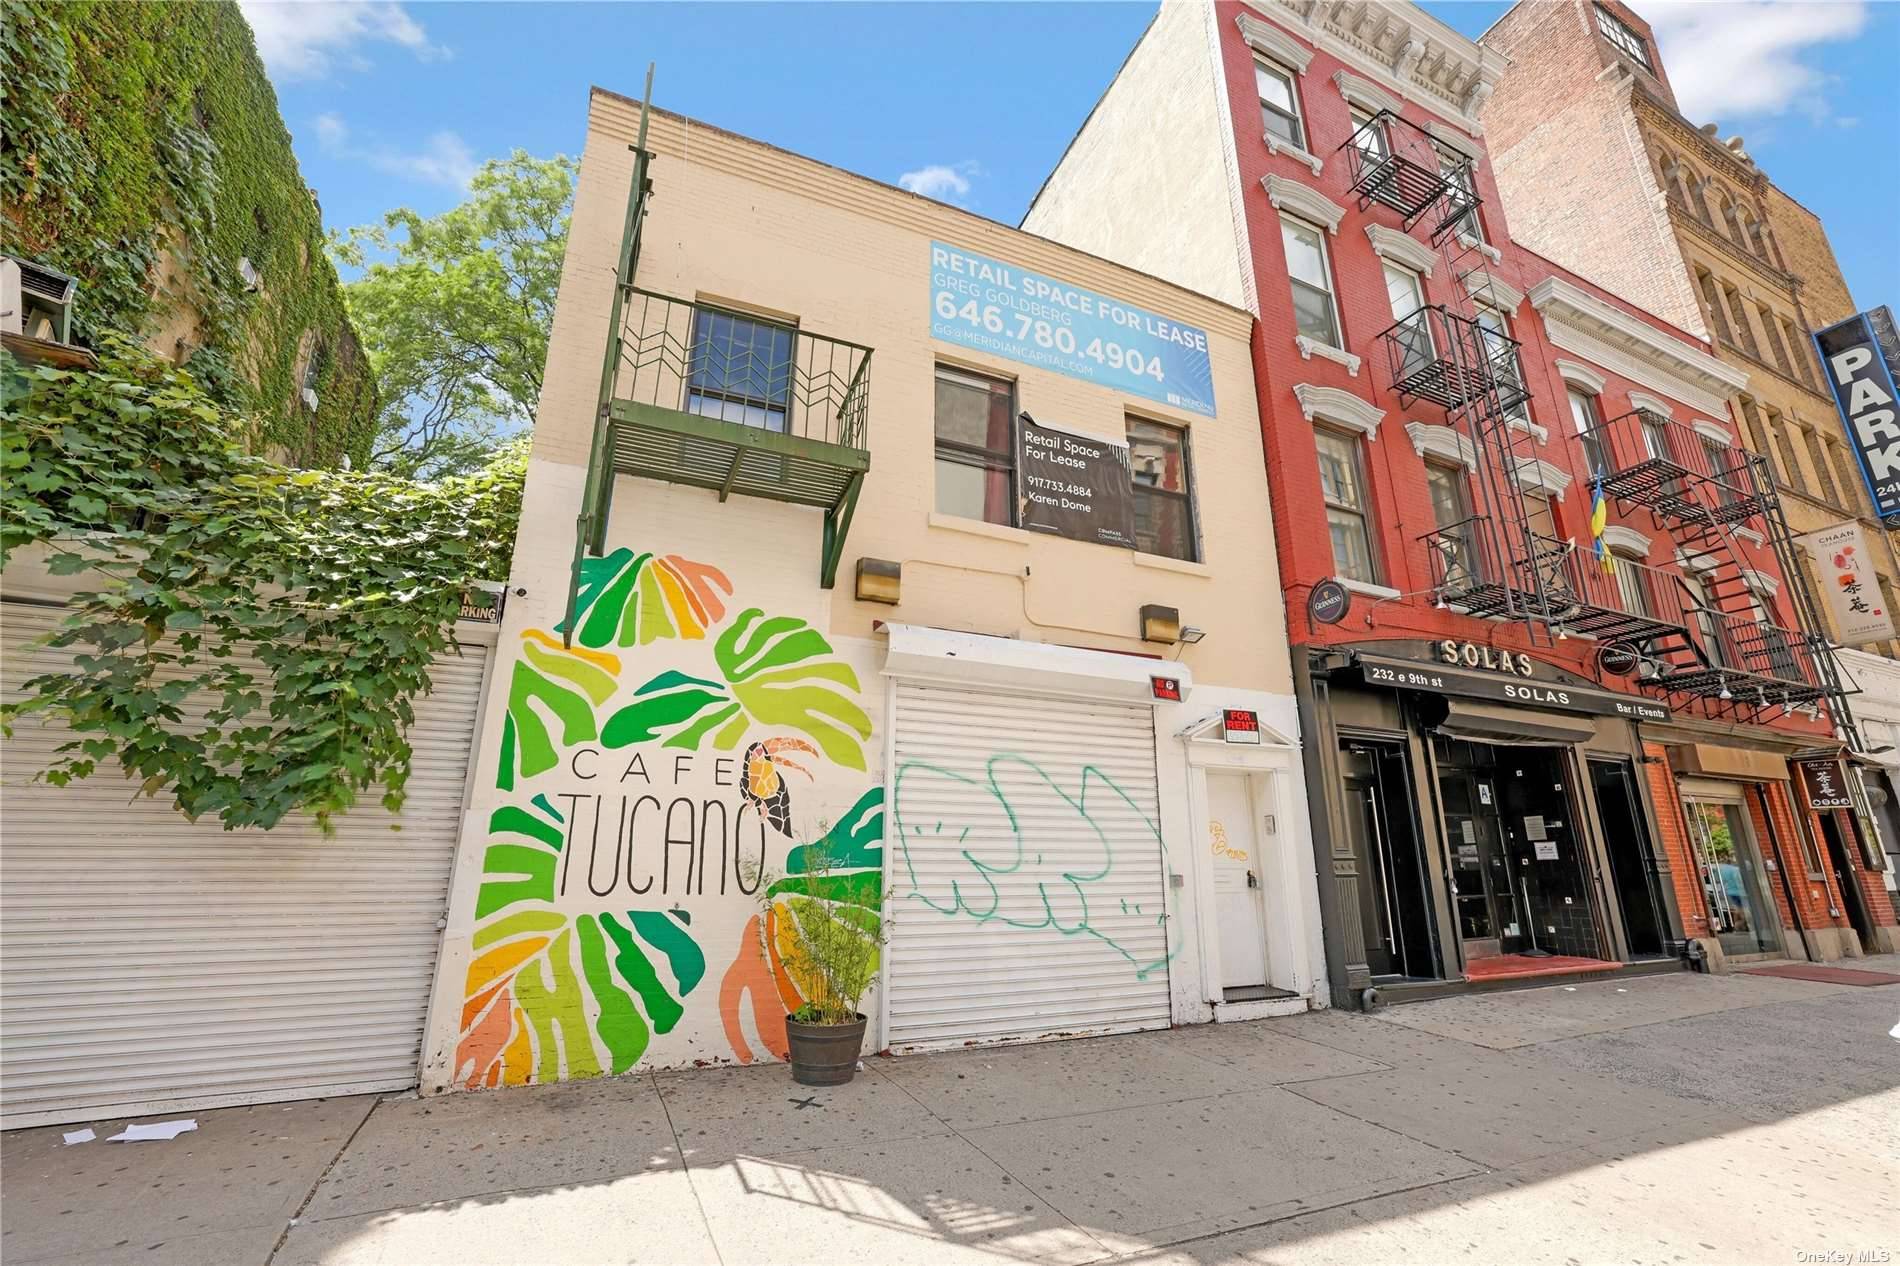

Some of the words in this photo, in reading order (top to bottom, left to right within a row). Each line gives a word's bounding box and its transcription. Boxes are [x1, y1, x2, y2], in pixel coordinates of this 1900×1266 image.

[933, 247, 1016, 290] RETAIL
[1023, 277, 1092, 315] SPACE
[1098, 301, 1141, 331] FOR
[1147, 317, 1207, 352] LEASE
[934, 272, 980, 297] GREG
[986, 288, 1072, 326] GOLDBERG
[935, 291, 1164, 382] 646.780.4904
[934, 322, 1093, 376] GG@MERIDIANCAPITAL.COM
[1025, 431, 1060, 449] Retail
[1064, 440, 1100, 458] Space
[1026, 445, 1046, 460] For
[1049, 451, 1086, 469] Lease
[1028, 476, 1092, 497] 917.733.4884
[1028, 491, 1059, 507] Karen
[1061, 498, 1091, 512] Dome
[457, 605, 496, 619] RKING
[1315, 594, 1341, 611] GUINNESS
[1442, 640, 1533, 677] SOLAS
[1372, 668, 1395, 681] 232
[1398, 673, 1406, 682] e
[1409, 673, 1428, 687] 9th
[1431, 677, 1443, 688] st
[1504, 685, 1570, 705] SOLAS
[1231, 711, 1250, 720] FOR
[1616, 703, 1631, 714] Bar
[1638, 706, 1665, 719] Events
[1226, 720, 1256, 731] RENT
[572, 749, 734, 786] CAFE
[1481, 787, 1489, 799] A
[558, 793, 766, 897] TUCANO
